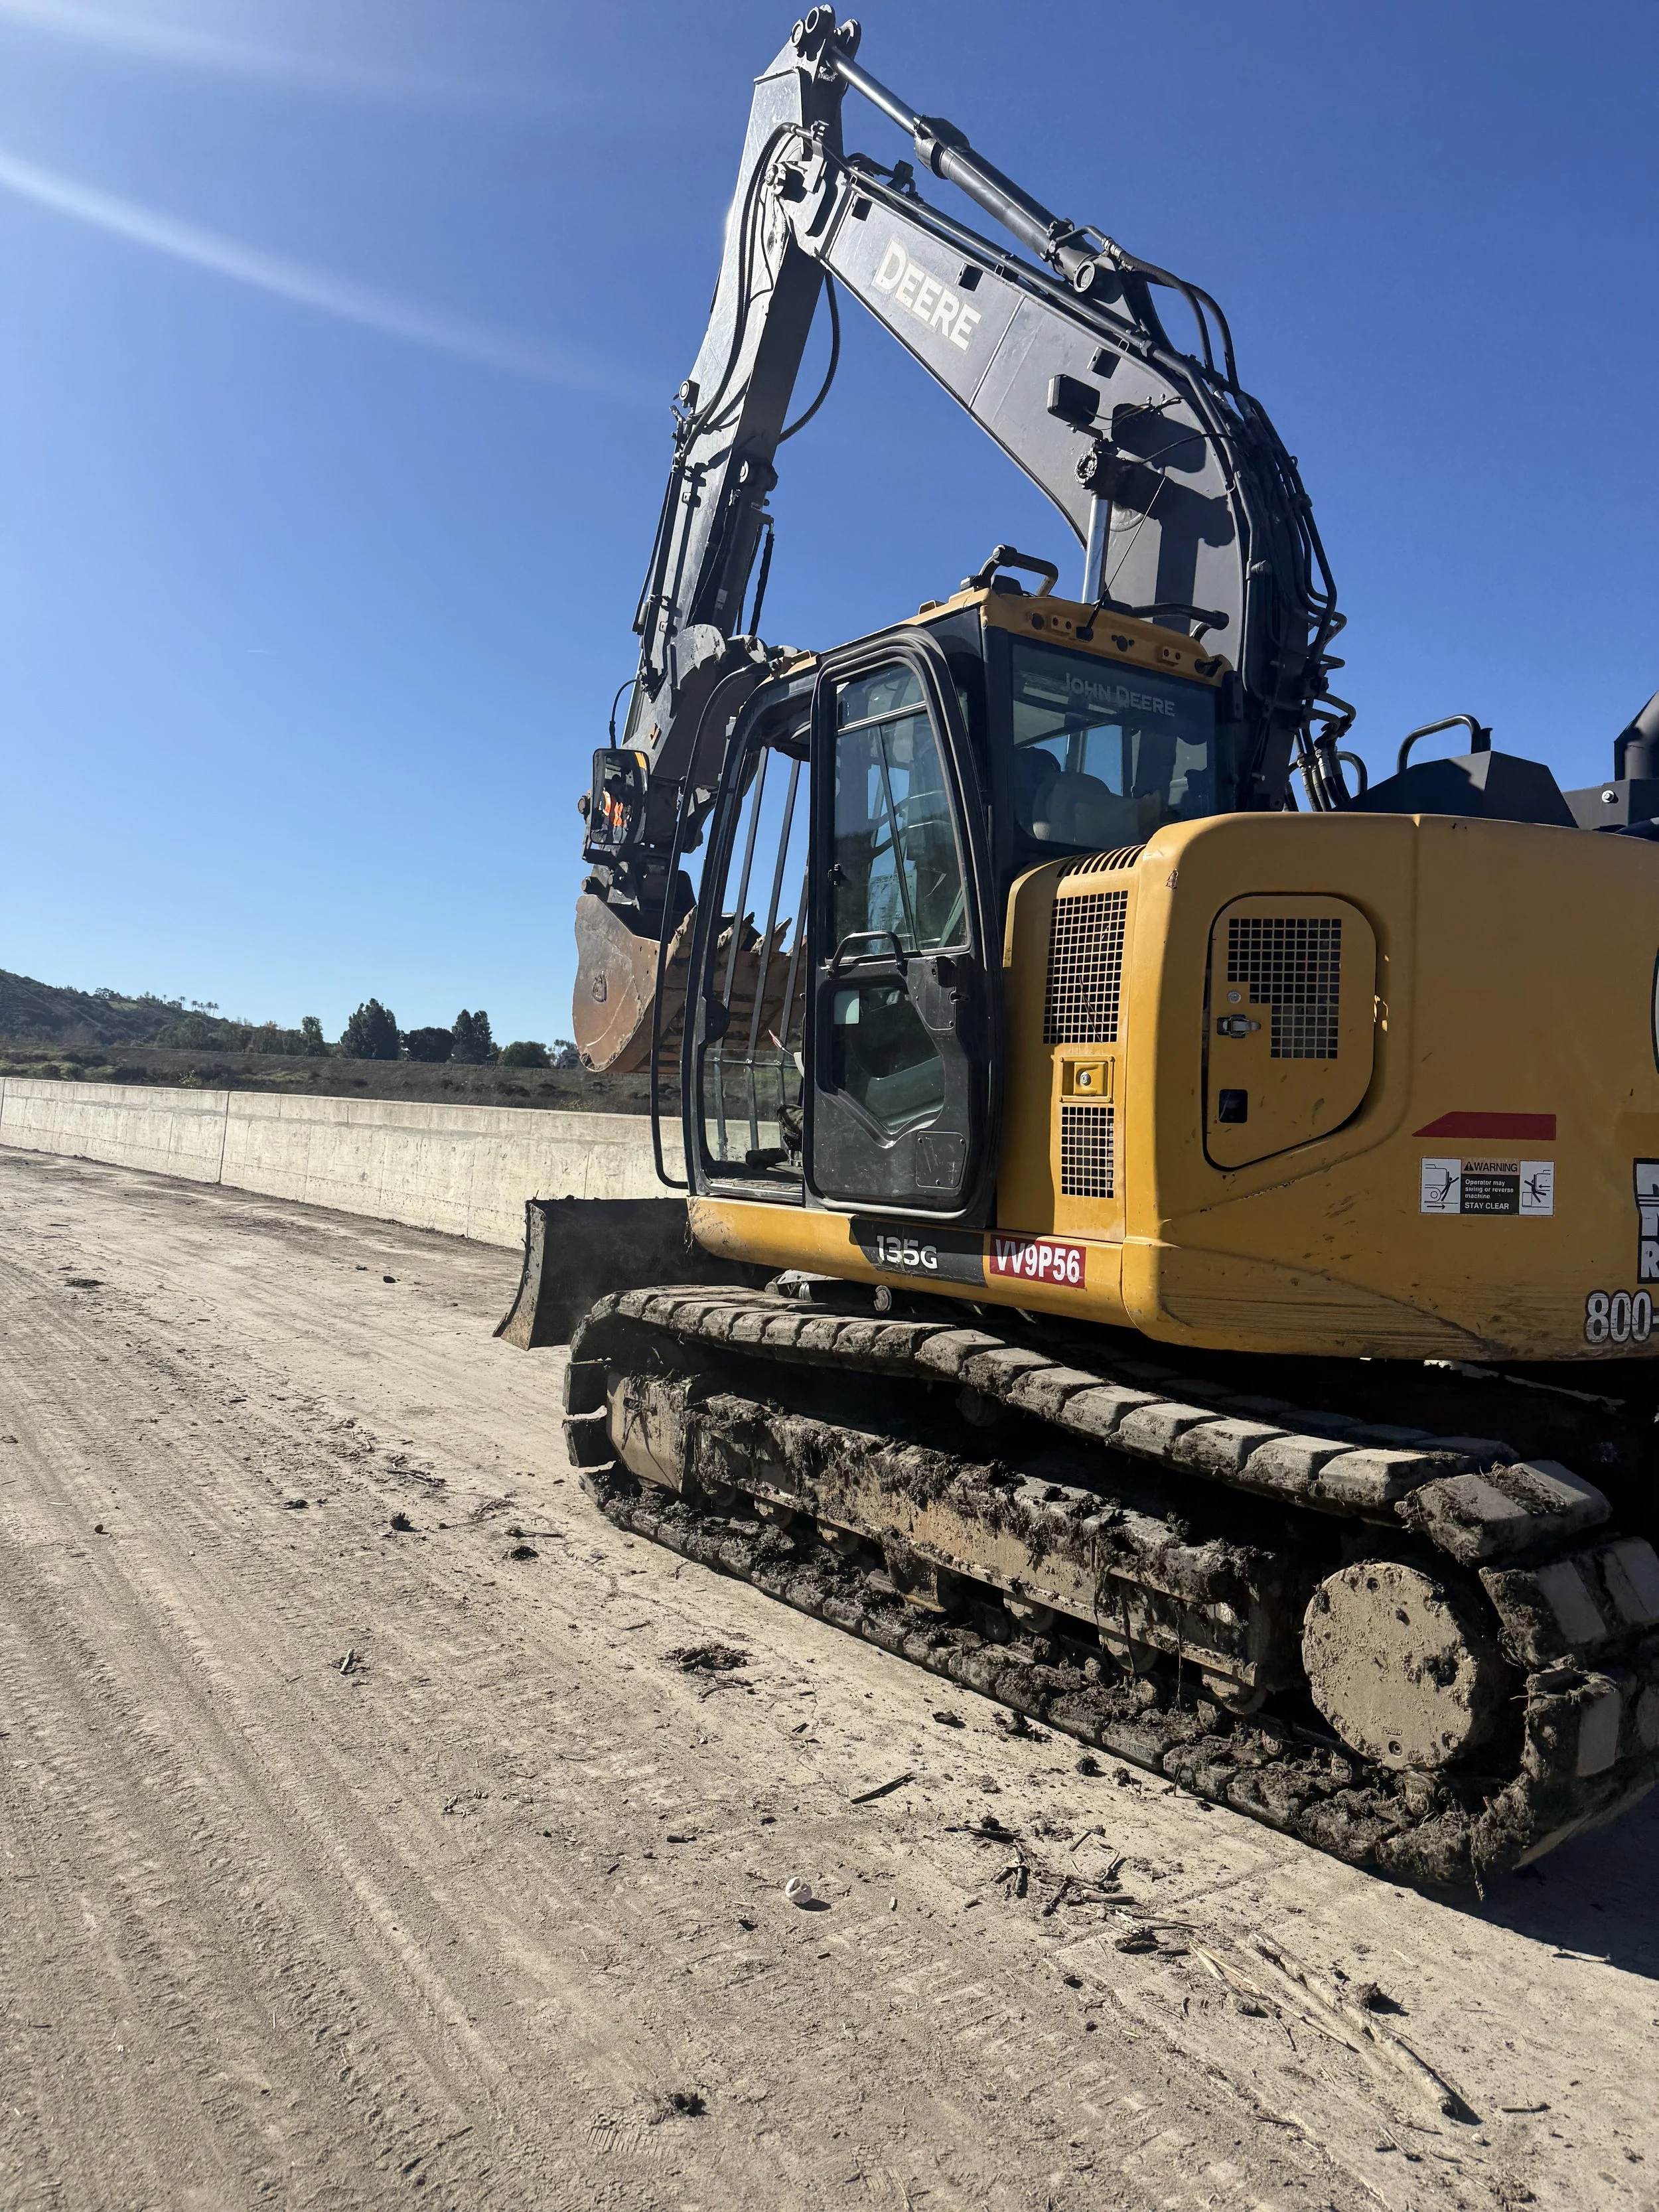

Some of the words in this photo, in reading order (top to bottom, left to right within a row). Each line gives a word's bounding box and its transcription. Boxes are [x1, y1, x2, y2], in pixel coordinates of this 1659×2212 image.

[875, 240, 981, 350] DEERE
[1061, 672, 1111, 702] JOHN
[1116, 685, 1175, 717] DEERE
[1474, 1162, 1518, 1172] WARNING
[877, 1235, 938, 1270] 135G
